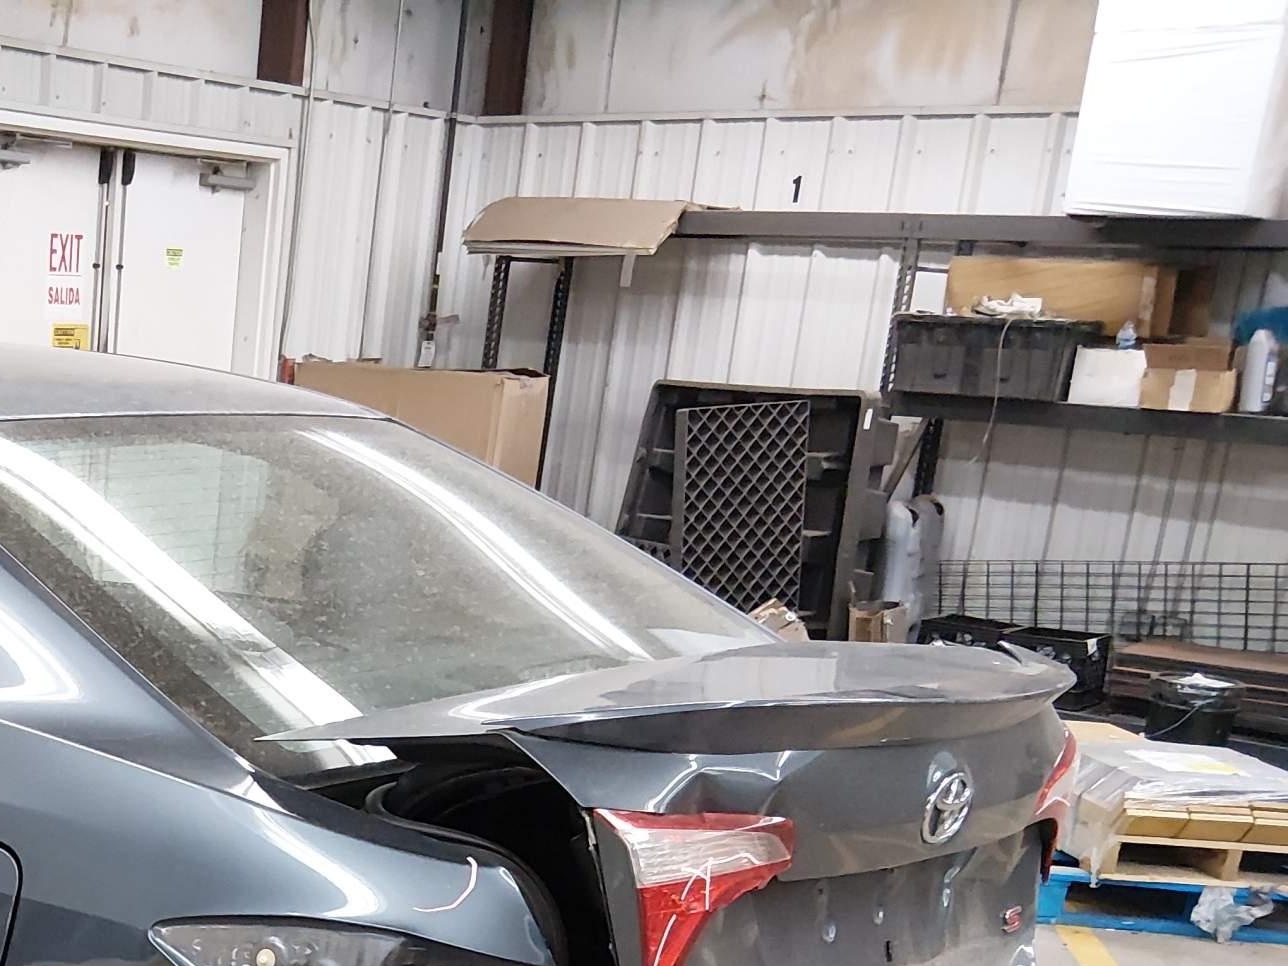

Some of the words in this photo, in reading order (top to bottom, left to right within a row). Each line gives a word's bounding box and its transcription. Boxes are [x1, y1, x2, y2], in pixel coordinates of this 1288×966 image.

[792, 175, 803, 203] 1
[49, 233, 84, 273] EXIT
[47, 286, 81, 306] SALIDA
